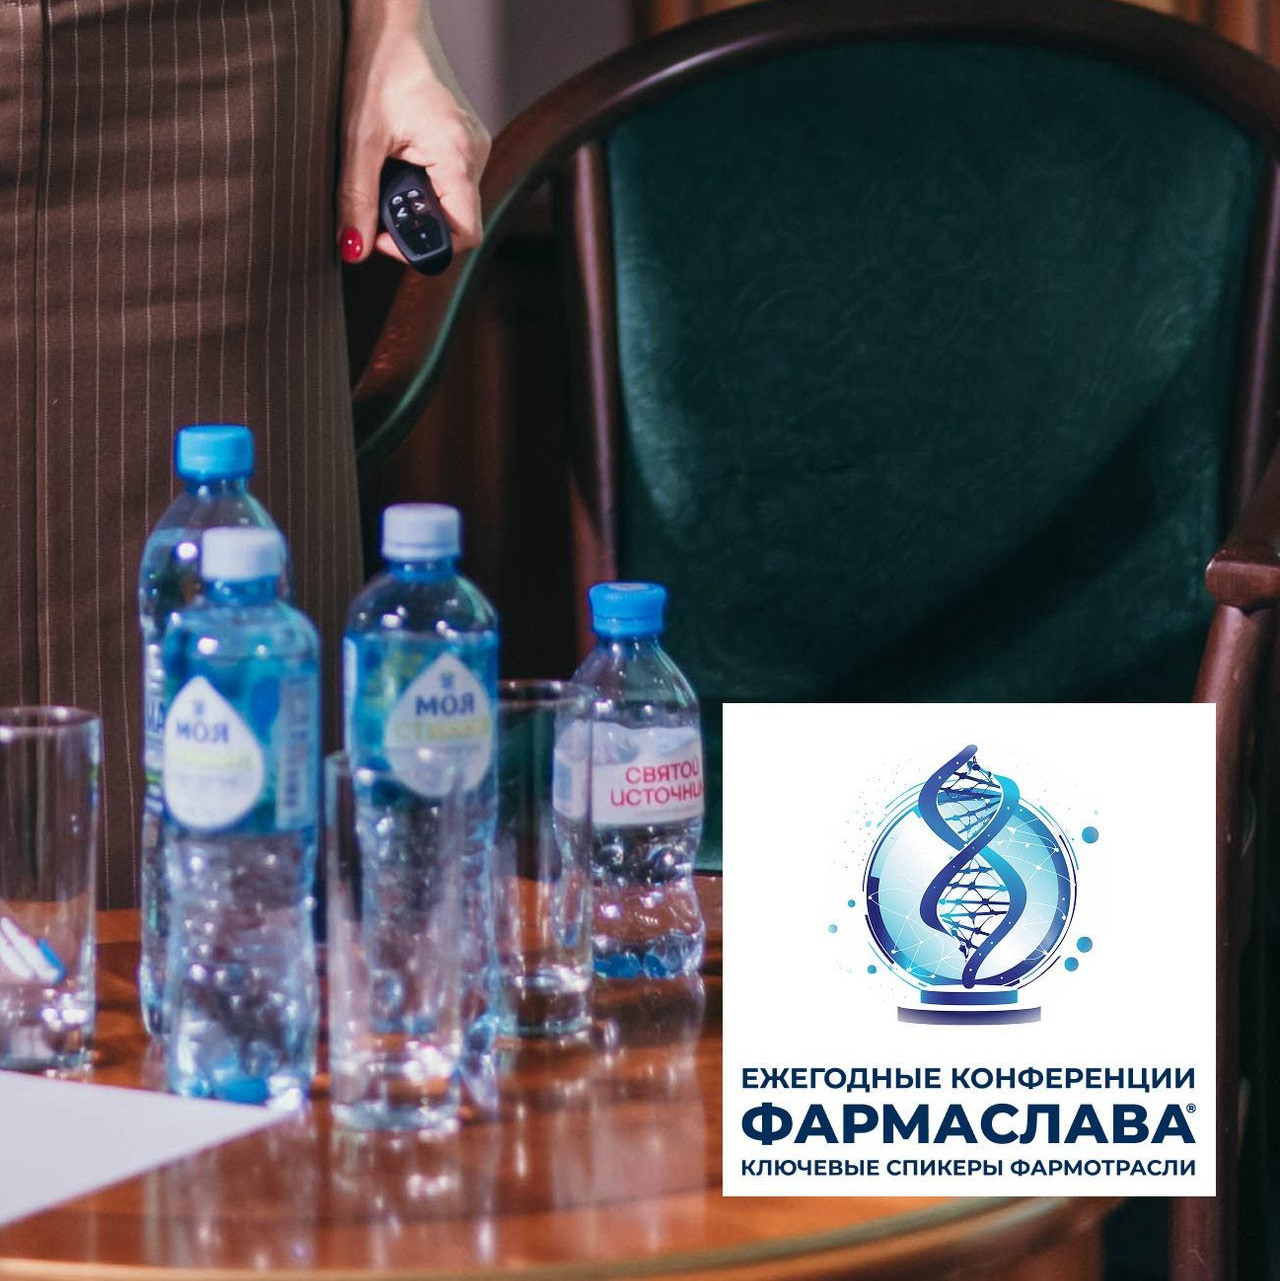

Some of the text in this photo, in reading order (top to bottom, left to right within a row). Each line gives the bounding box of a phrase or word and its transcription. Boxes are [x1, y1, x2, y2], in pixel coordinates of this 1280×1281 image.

[415, 692, 475, 716] МОЯ
[176, 720, 229, 744] МОЯ
[610, 779, 704, 806] ИСТОЧНИ
